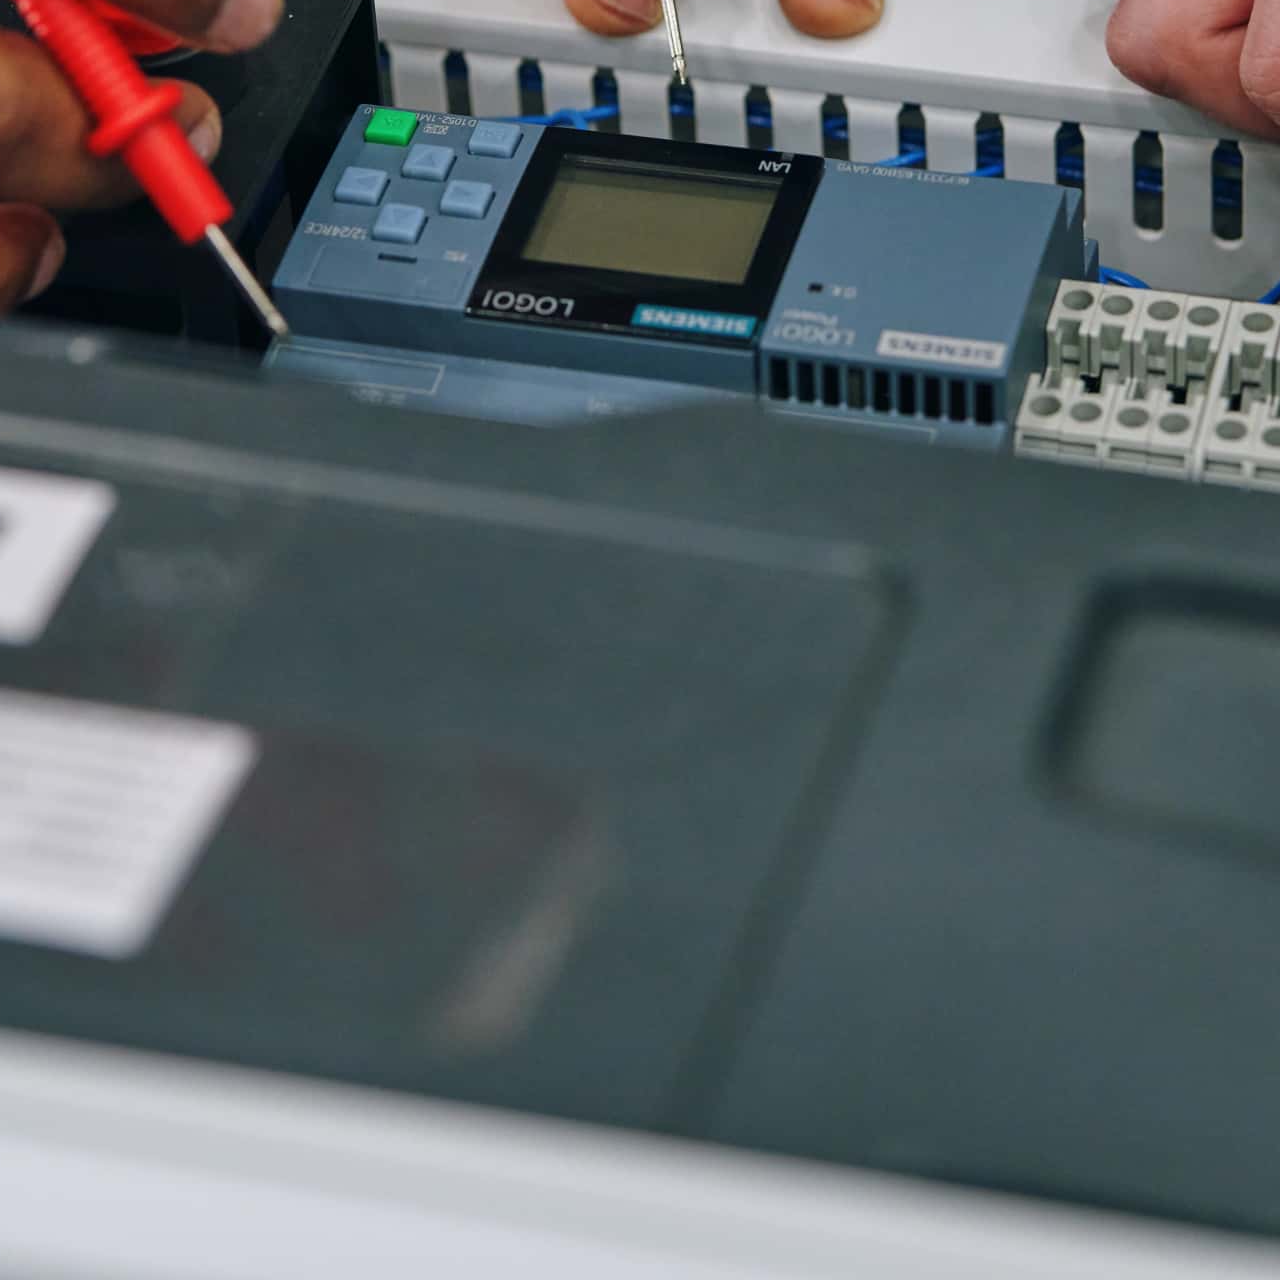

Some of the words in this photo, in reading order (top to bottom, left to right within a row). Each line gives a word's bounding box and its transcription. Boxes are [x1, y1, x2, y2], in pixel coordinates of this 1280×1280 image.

[758, 160, 792, 174] LAN
[481, 289, 574, 318] LOGO!
[640, 309, 750, 335] SIEMENS
[773, 323, 856, 347] LOGO!
[887, 337, 995, 362] SIEMENS
